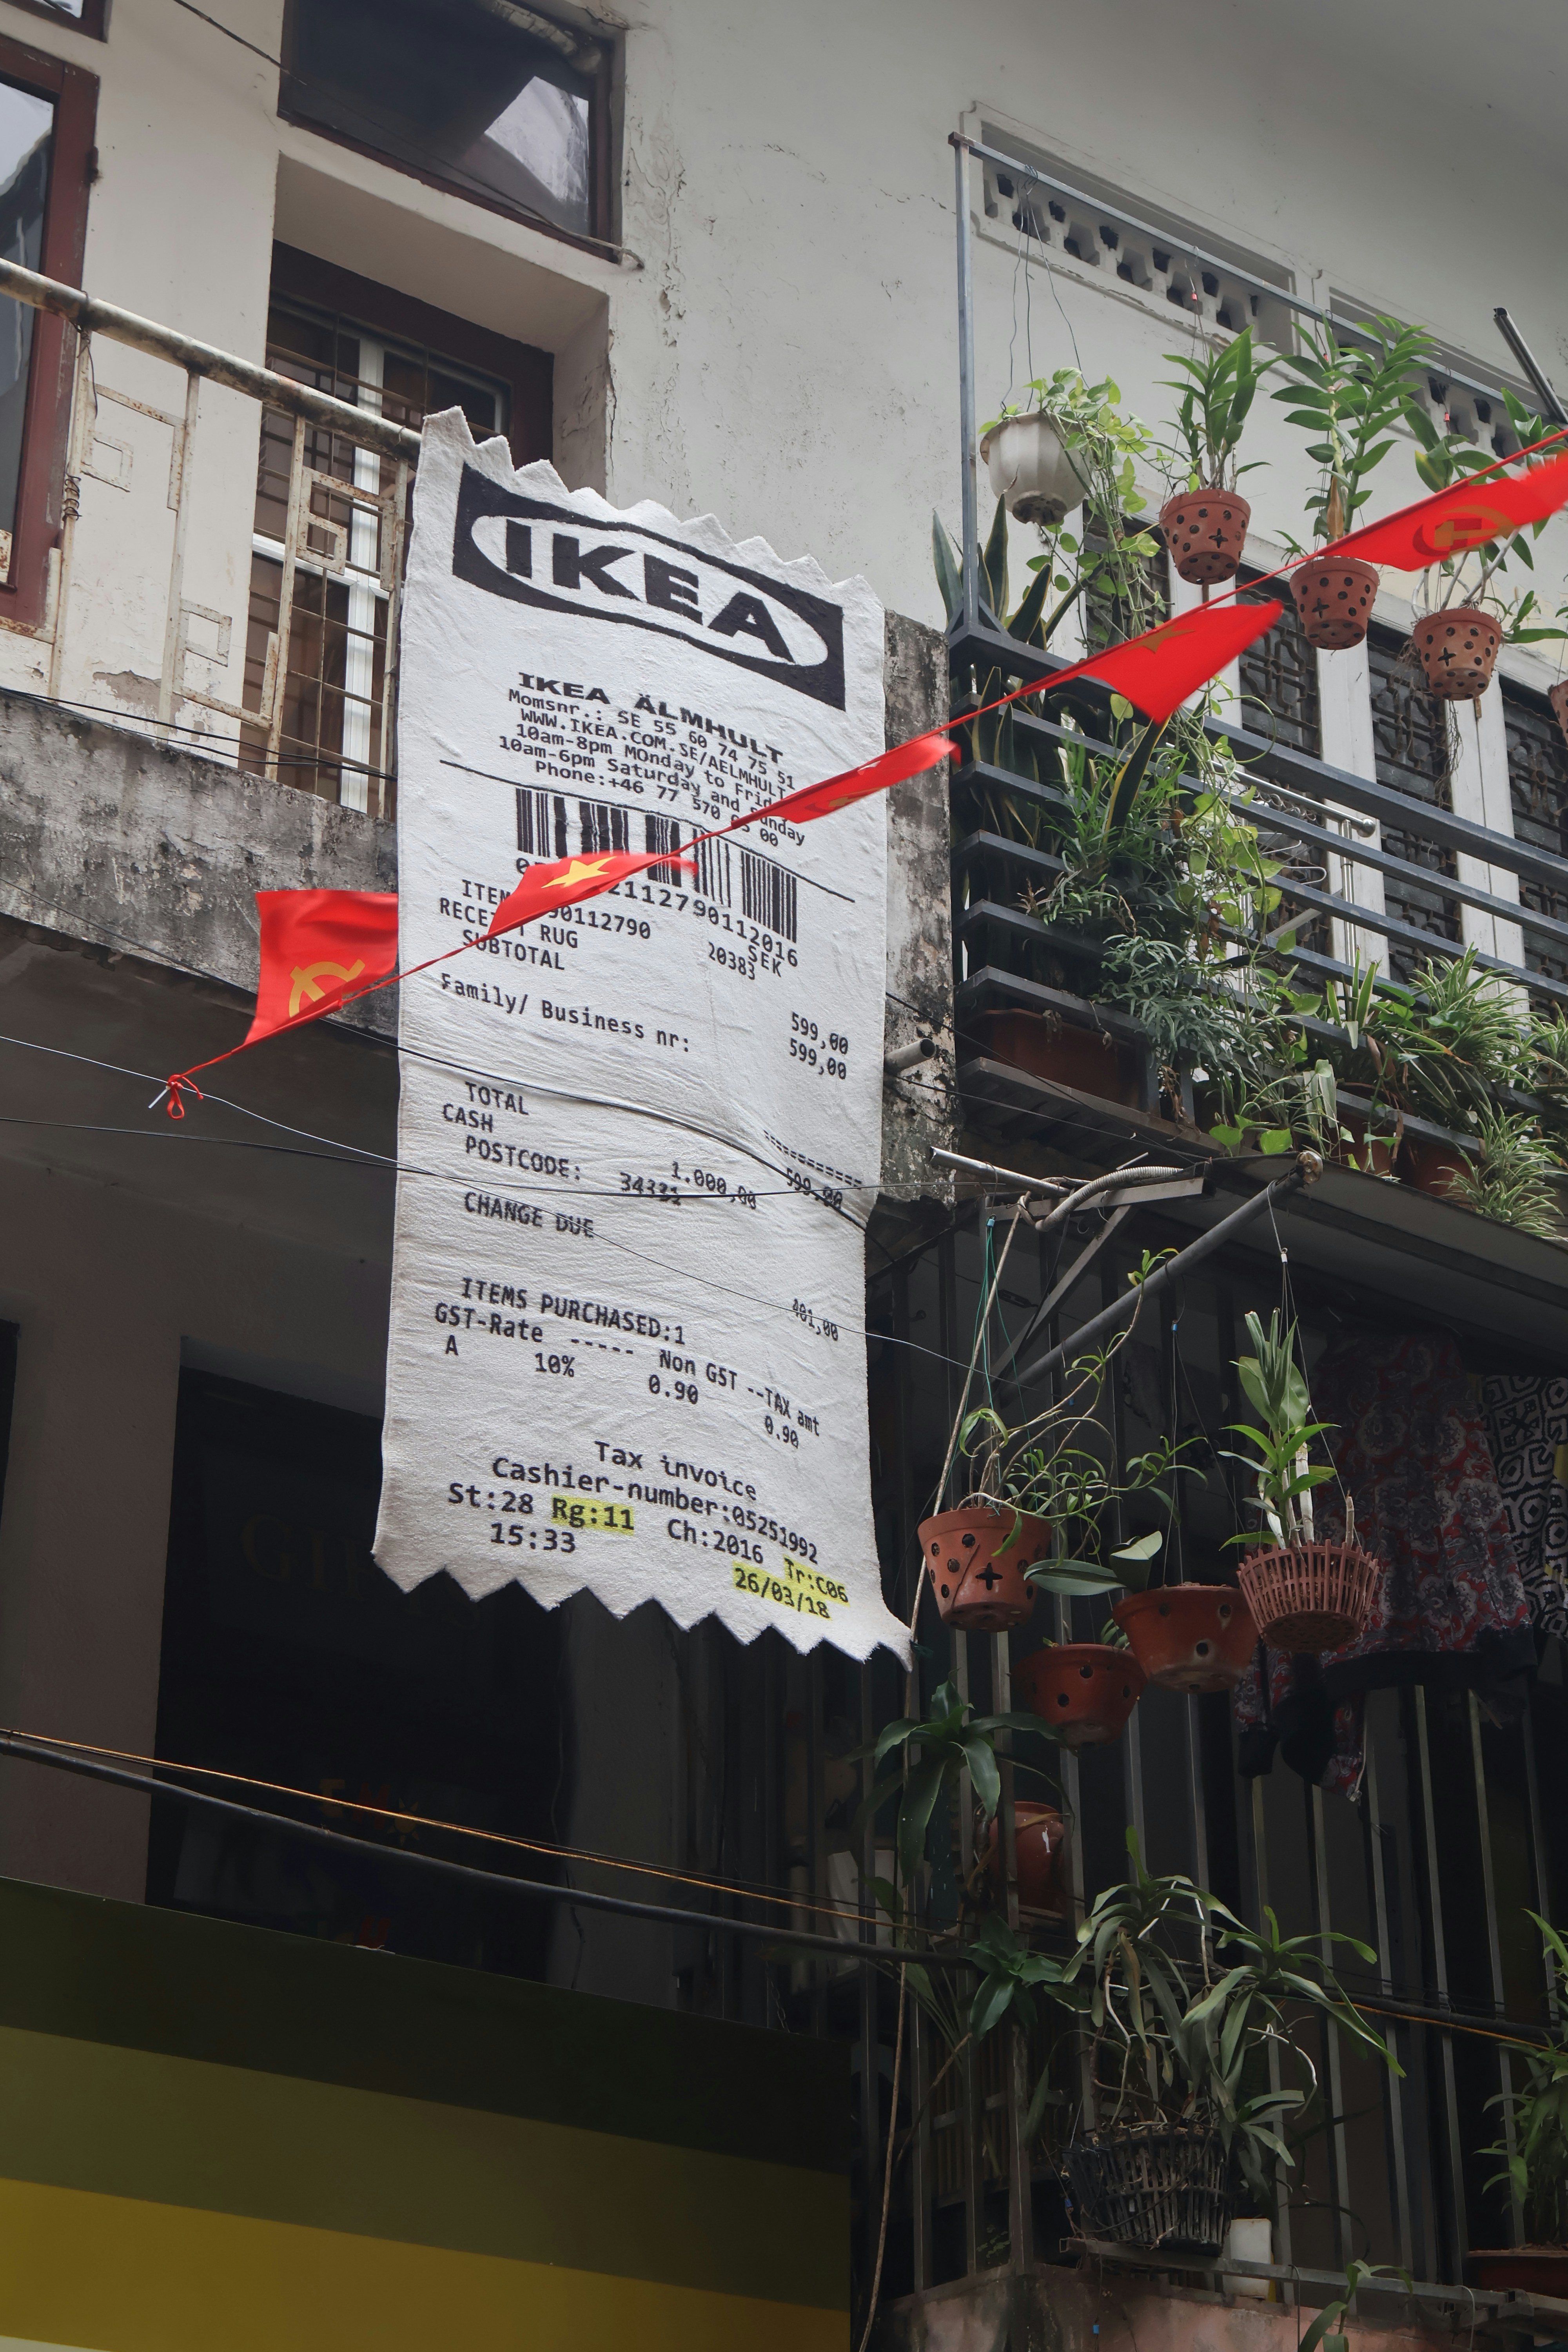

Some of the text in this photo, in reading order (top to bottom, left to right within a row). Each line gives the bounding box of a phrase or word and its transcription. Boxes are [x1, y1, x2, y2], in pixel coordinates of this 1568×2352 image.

[506, 519, 796, 664] IKEA
[509, 689, 795, 790] Momsnr.: SE 55 60 74 75 51
[519, 672, 783, 763] IKEA ÄLMHULT
[499, 736, 595, 768] 10am-6pm
[608, 758, 701, 797] Saturday
[711, 789, 740, 812] and
[517, 724, 613, 755] 10am-8pm
[625, 744, 695, 779] MOnday
[705, 770, 724, 788] to
[521, 708, 786, 800] WWW.IKEA.COM.SE/AELMHULT
[536, 760, 779, 847] Phone:+46 77 570 00
[463, 929, 564, 970] SUBTOTAL
[541, 924, 578, 948] RUG
[708, 942, 755, 980] 20383
[748, 945, 782, 977] SEK
[441, 973, 689, 1052] Family/ Business nr:
[792, 1011, 849, 1055] 599,00
[789, 1038, 847, 1080] 599,00
[443, 1103, 493, 1132] CASH
[465, 1082, 529, 1115] TOTAL
[466, 1135, 581, 1181] POSTCODE:
[465, 1191, 594, 1238] CHANGE DUE
[461, 1276, 685, 1345] ITEMS PURCHASED:1
[435, 1302, 543, 1343] GST-Rate
[660, 1349, 696, 1376] Non
[706, 1363, 737, 1390] GST
[797, 1410, 820, 1437] amt
[445, 1334, 799, 1449] A 10% 0.90 0.90
[594, 1440, 757, 1501] Tax invoice
[448, 1483, 848, 1603] St:28 Rg:11 Ch:2016 Tr:C06
[491, 1522, 830, 1619] 15:33 26/03/18
